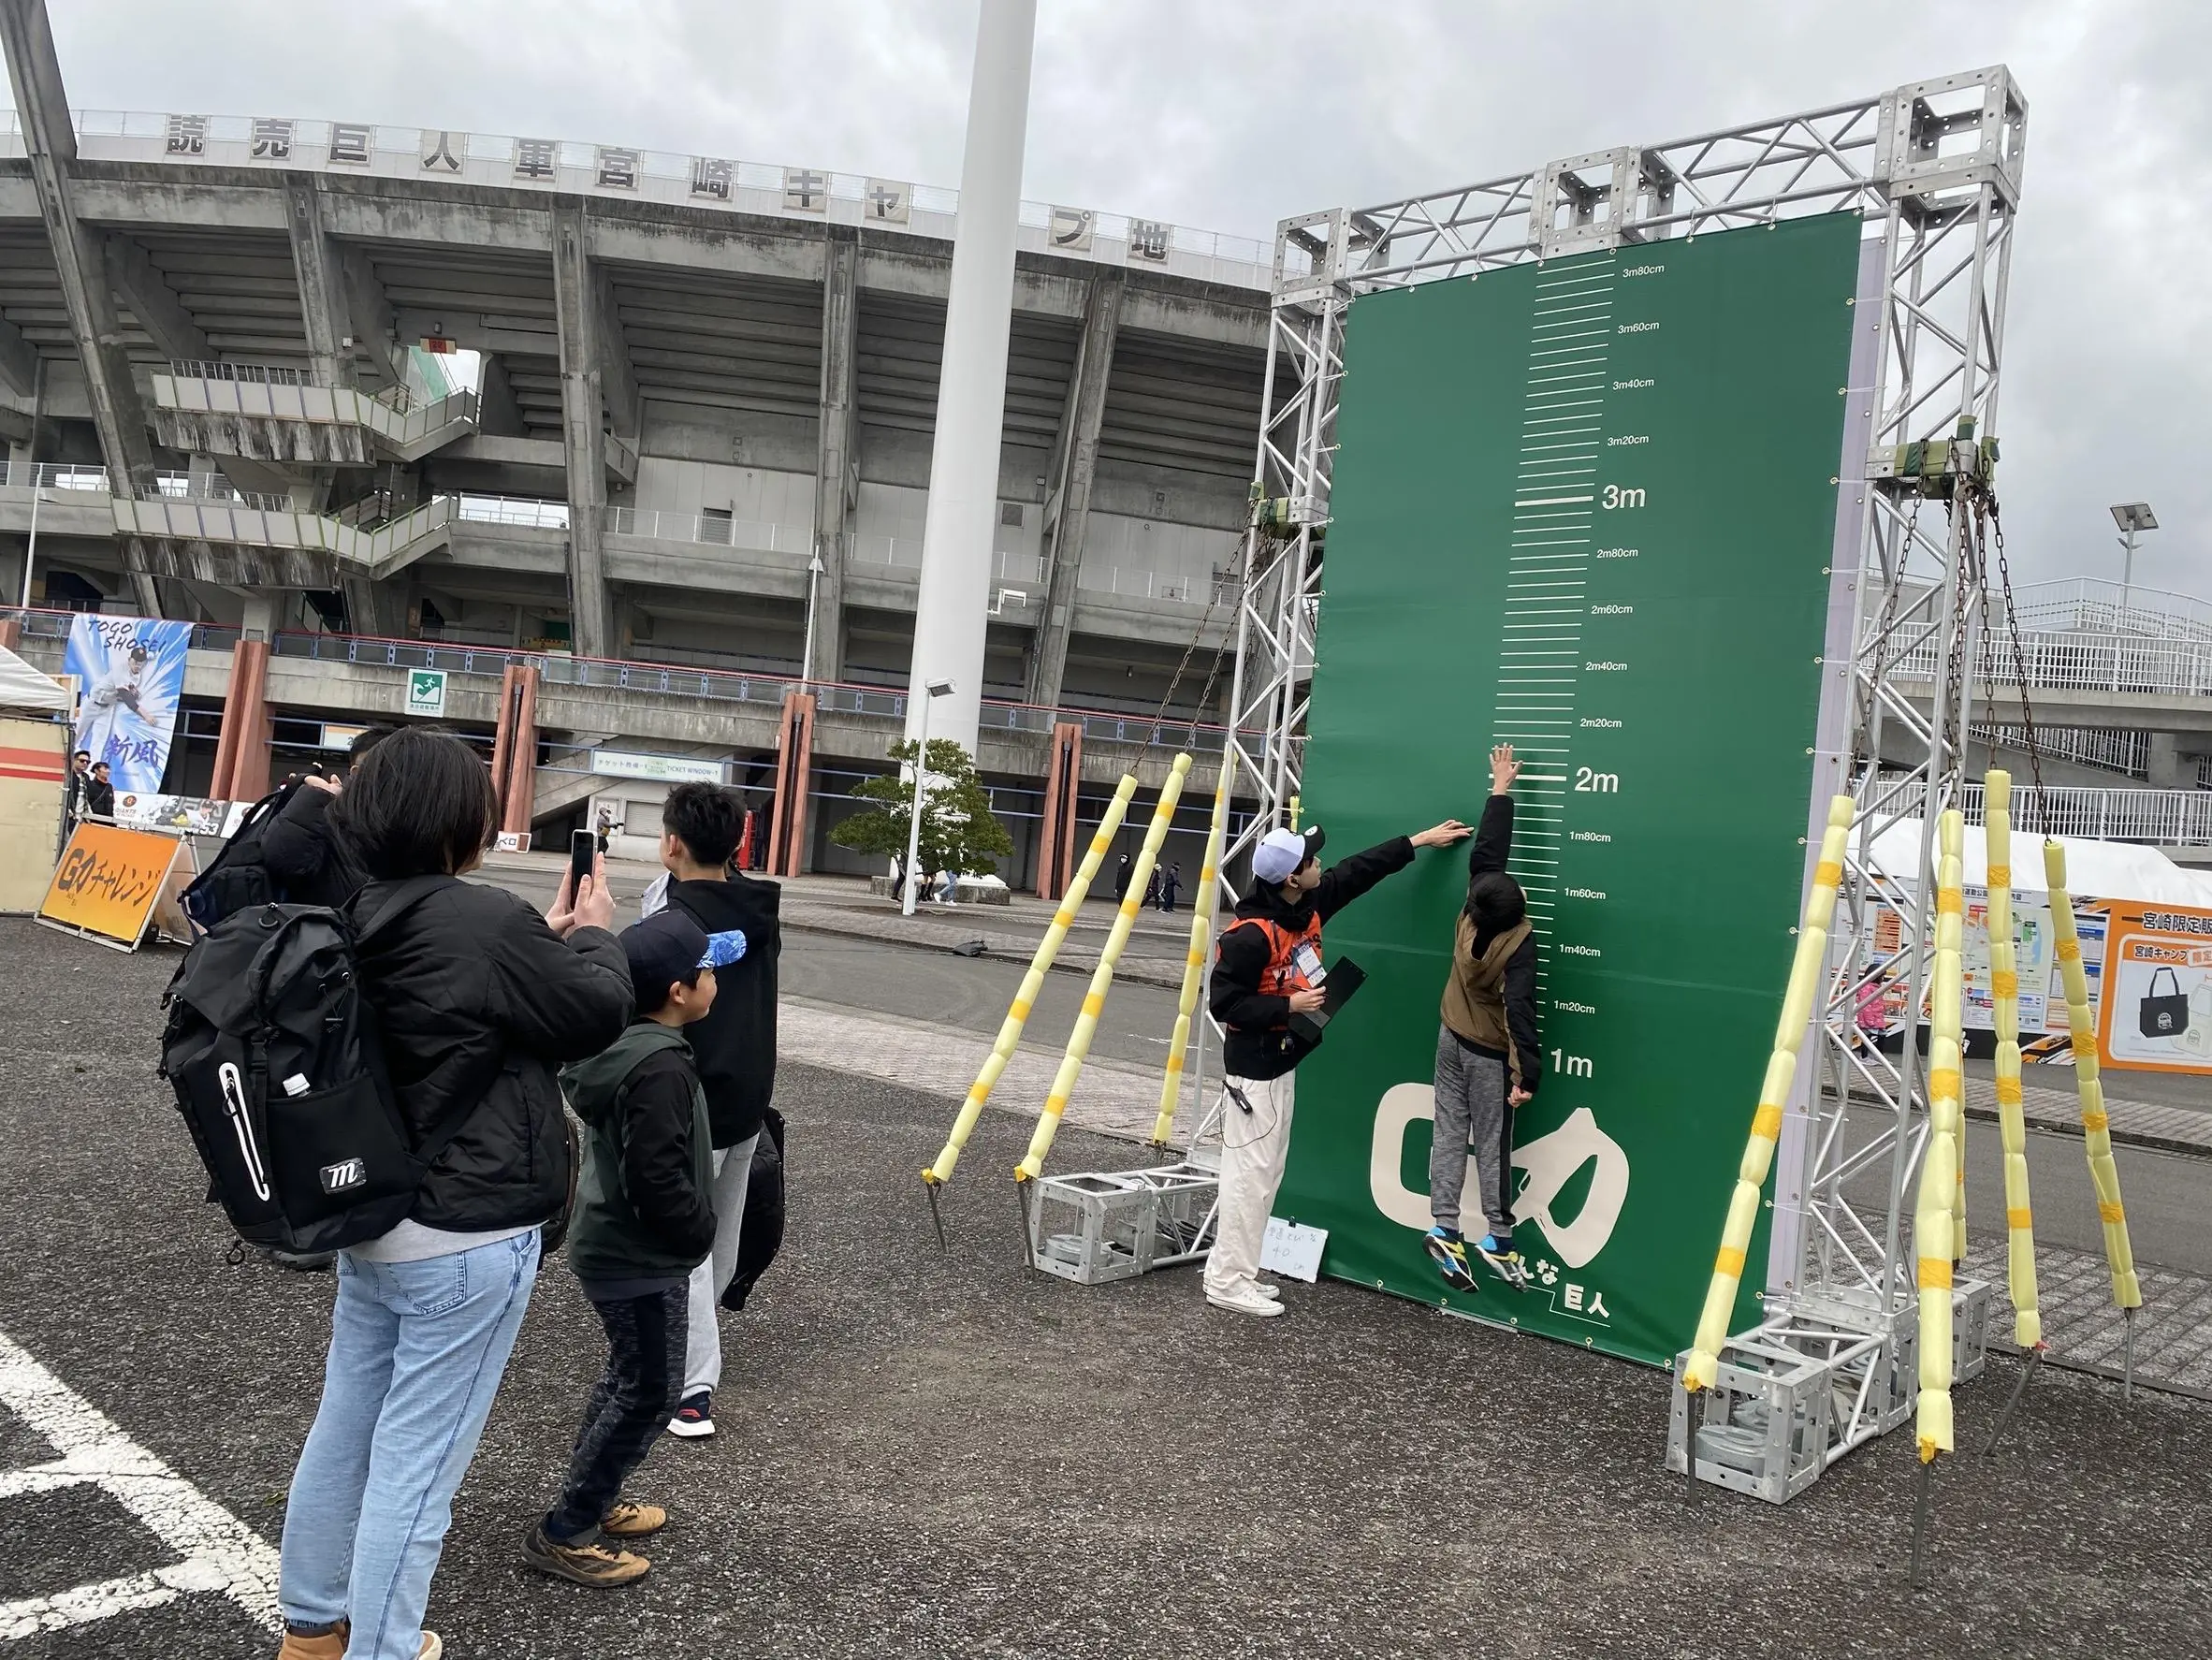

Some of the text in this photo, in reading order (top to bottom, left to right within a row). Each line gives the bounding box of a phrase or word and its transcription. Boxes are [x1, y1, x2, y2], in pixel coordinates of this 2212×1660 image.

[167, 114, 1167, 261] 読売巨人軍宮崎キャプ地
[1623, 265, 1665, 278] 3m80cm
[1617, 322, 1660, 334] 3m60cm
[1612, 378, 1654, 390] 3m40cm
[1607, 435, 1650, 446] 3m20cm
[1601, 484, 1647, 510] 3m
[1596, 547, 1638, 559] 2m80cm
[1591, 604, 1634, 615] 2m60cm
[88, 618, 133, 636] TOGO
[103, 635, 167, 653] SHOSEI
[1585, 661, 1628, 671] 2m40cm
[1579, 718, 1623, 728] 2m20cm
[104, 734, 159, 769] 新風
[1574, 766, 1619, 794] 2m
[1569, 831, 1611, 843] 1m80cm
[1564, 887, 1607, 900] 1m60cm
[2143, 912, 2212, 934] 宮崎限定販
[1559, 943, 1601, 957] 1m40cm
[1553, 999, 1595, 1014] 1m20cm
[1550, 1048, 1593, 1079] 1m
[1564, 1283, 1610, 1318] 巨人
